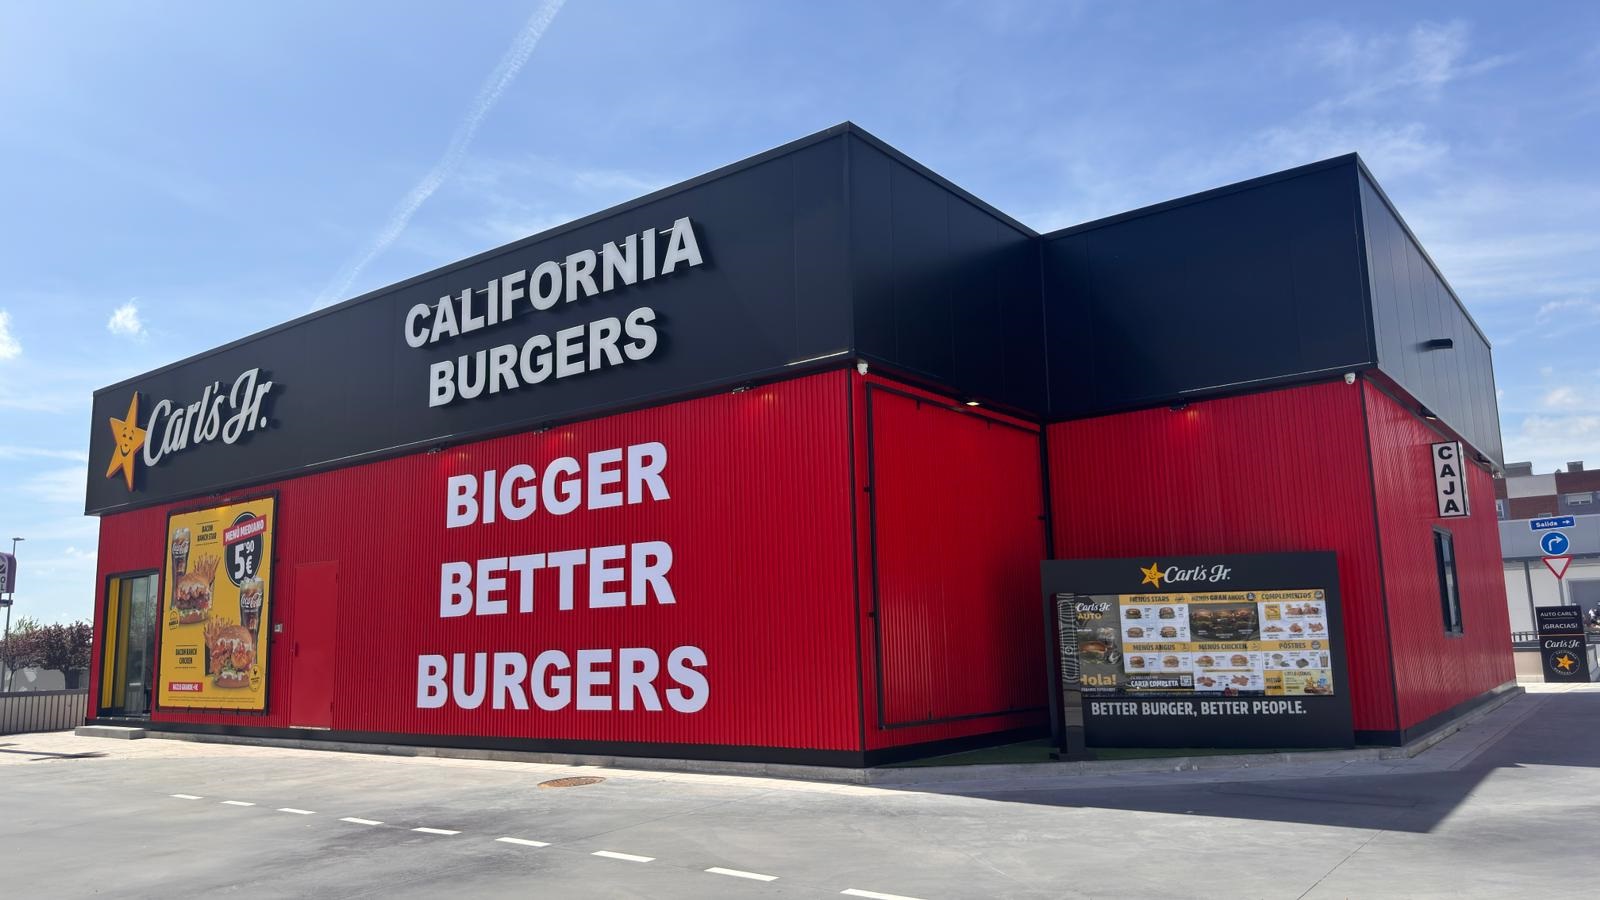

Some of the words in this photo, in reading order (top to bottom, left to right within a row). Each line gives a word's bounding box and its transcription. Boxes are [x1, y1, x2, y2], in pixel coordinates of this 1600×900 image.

[404, 216, 703, 348] CALIFORNIA
[429, 306, 658, 408] BURGERS
[143, 381, 225, 467] Carl's
[222, 368, 273, 445] Jr.
[446, 441, 671, 529] BIGGER
[1437, 446, 1460, 513] CAJA
[225, 526, 240, 542] MENÚ
[240, 519, 265, 537] MEDIANO
[440, 541, 676, 618] BETTER
[1163, 565, 1208, 584] Carl's
[1209, 564, 1231, 582] Jr.
[1261, 591, 1312, 600] COMPLEMENTOS
[1077, 612, 1102, 620] AUTO
[416, 645, 710, 713] BURGERS
[1091, 702, 1138, 716] BETTER
[1141, 702, 1198, 718] BURGER,
[1201, 701, 1249, 715] BETTER
[1252, 701, 1307, 714] PEOPLE.
[1131, 680, 1149, 688] CARTA
[1149, 680, 1179, 688] COMPLETA
